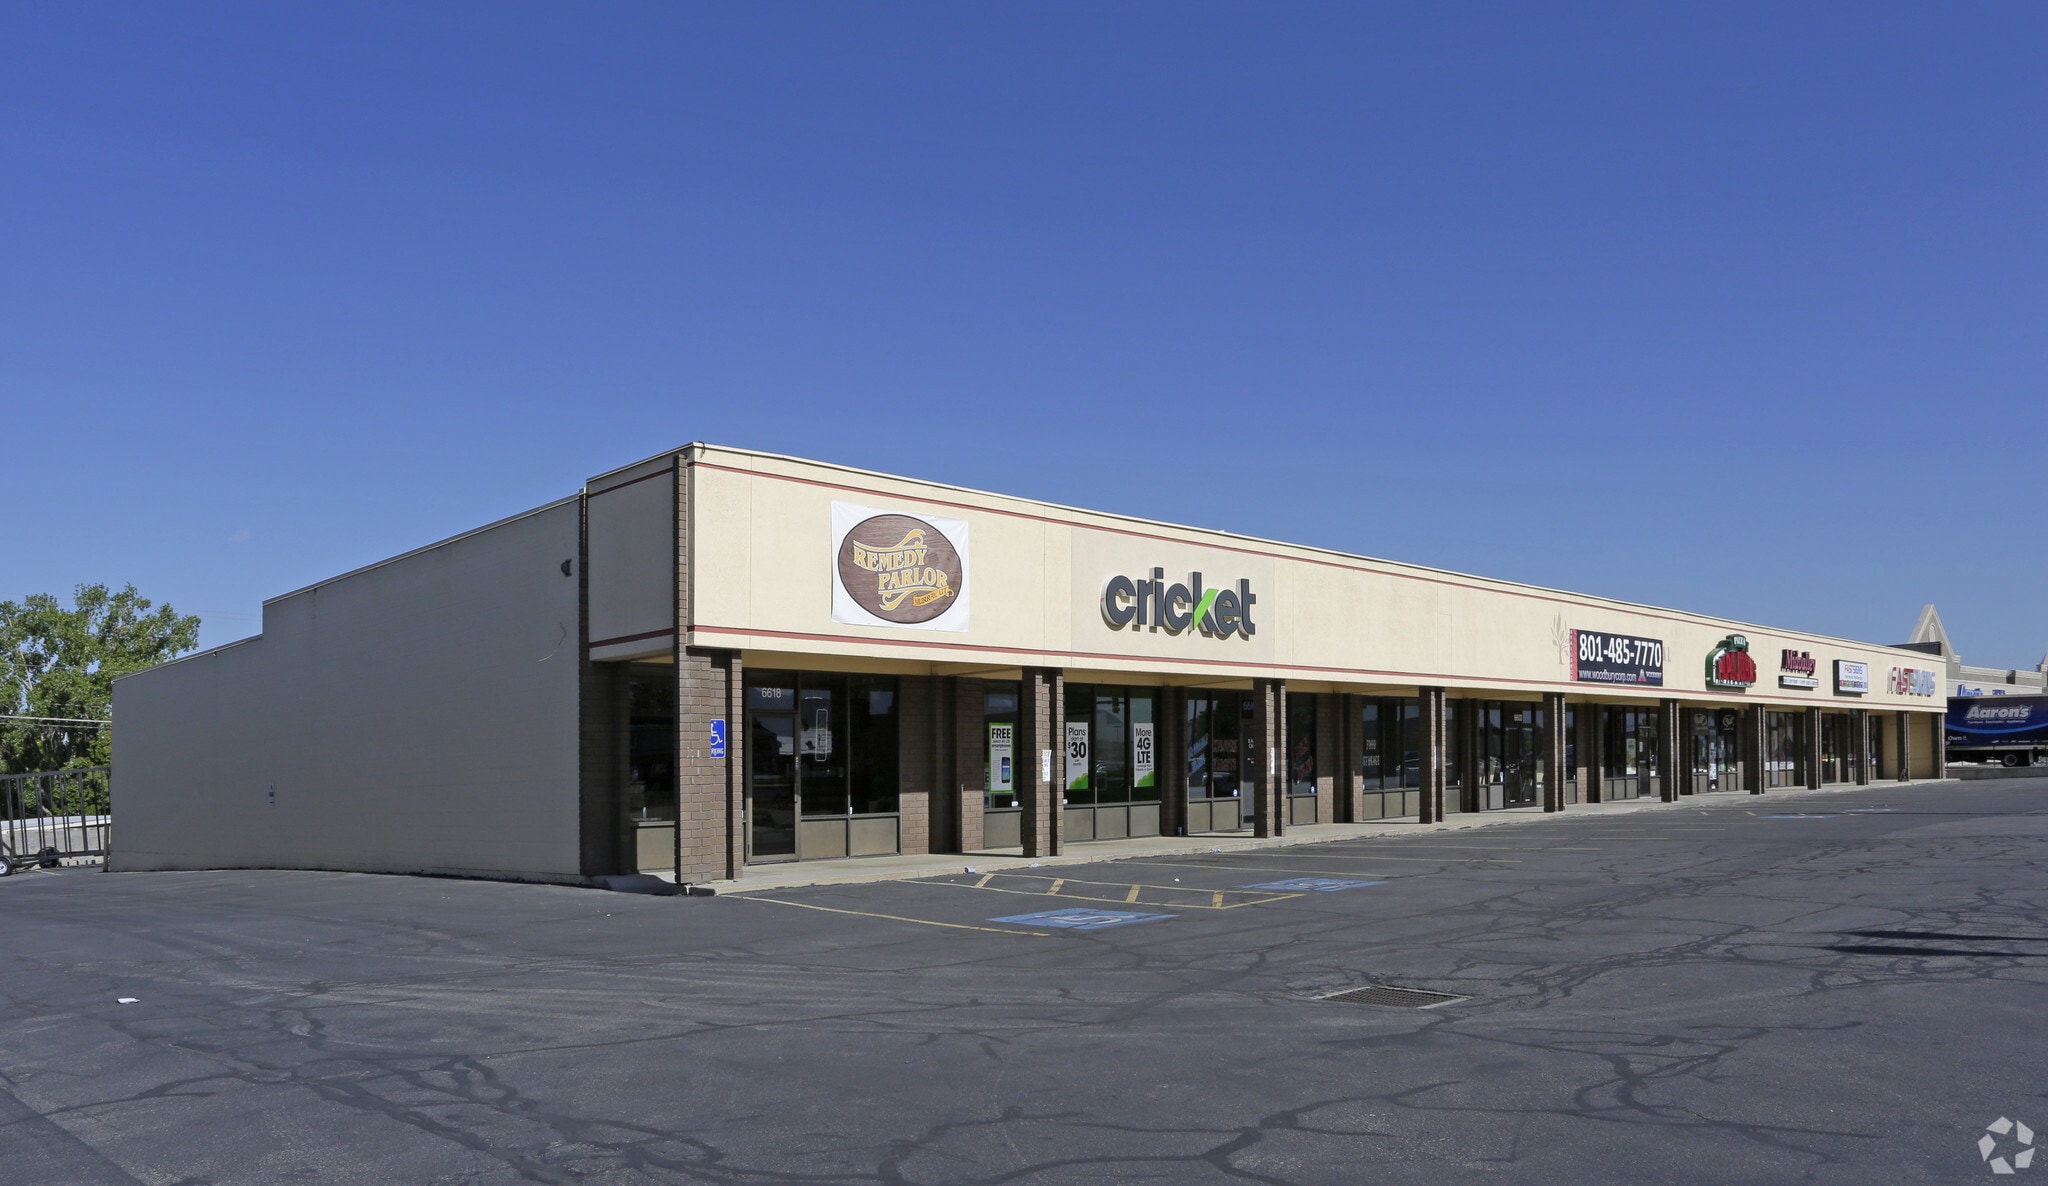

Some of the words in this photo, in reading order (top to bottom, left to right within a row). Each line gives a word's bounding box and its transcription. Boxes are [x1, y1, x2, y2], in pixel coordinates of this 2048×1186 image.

[853, 546, 927, 571] REMEDY
[878, 567, 947, 589] PARLOR
[1102, 567, 1256, 635] cricket
[1579, 634, 1662, 667] 801-485-7770
[1578, 669, 1637, 683] www.woodburycorp.com
[761, 688, 781, 698] 6618
[1965, 705, 2030, 719] Aaron's
[992, 728, 1011, 739] FREE
[1068, 727, 1086, 736] Plans
[1135, 728, 1152, 736] More
[1068, 741, 1086, 758] $30
[1137, 737, 1151, 750] 4G
[1137, 751, 1151, 763] LTE
